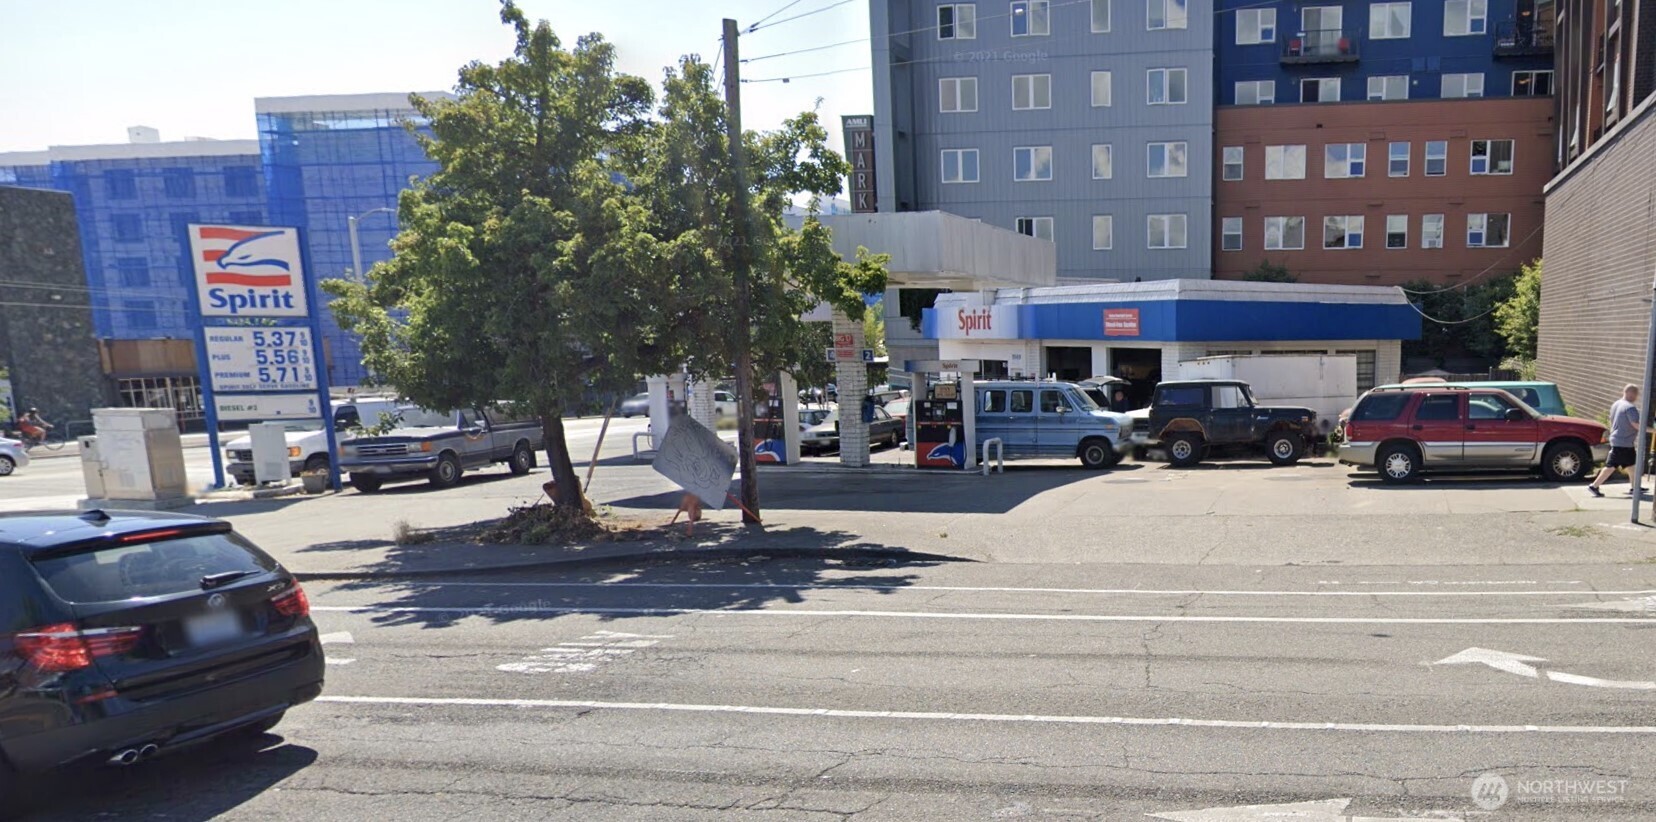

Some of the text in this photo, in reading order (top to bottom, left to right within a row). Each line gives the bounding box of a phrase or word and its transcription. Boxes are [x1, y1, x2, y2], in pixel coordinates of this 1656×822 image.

[845, 118, 867, 126] AMLI
[855, 132, 867, 209] MARK
[208, 287, 295, 313] Spirit
[958, 308, 992, 335] Spirit
[253, 331, 296, 347] 5.37
[256, 349, 299, 365] 5.56
[864, 351, 871, 359] 2
[258, 367, 299, 383] 5.71
